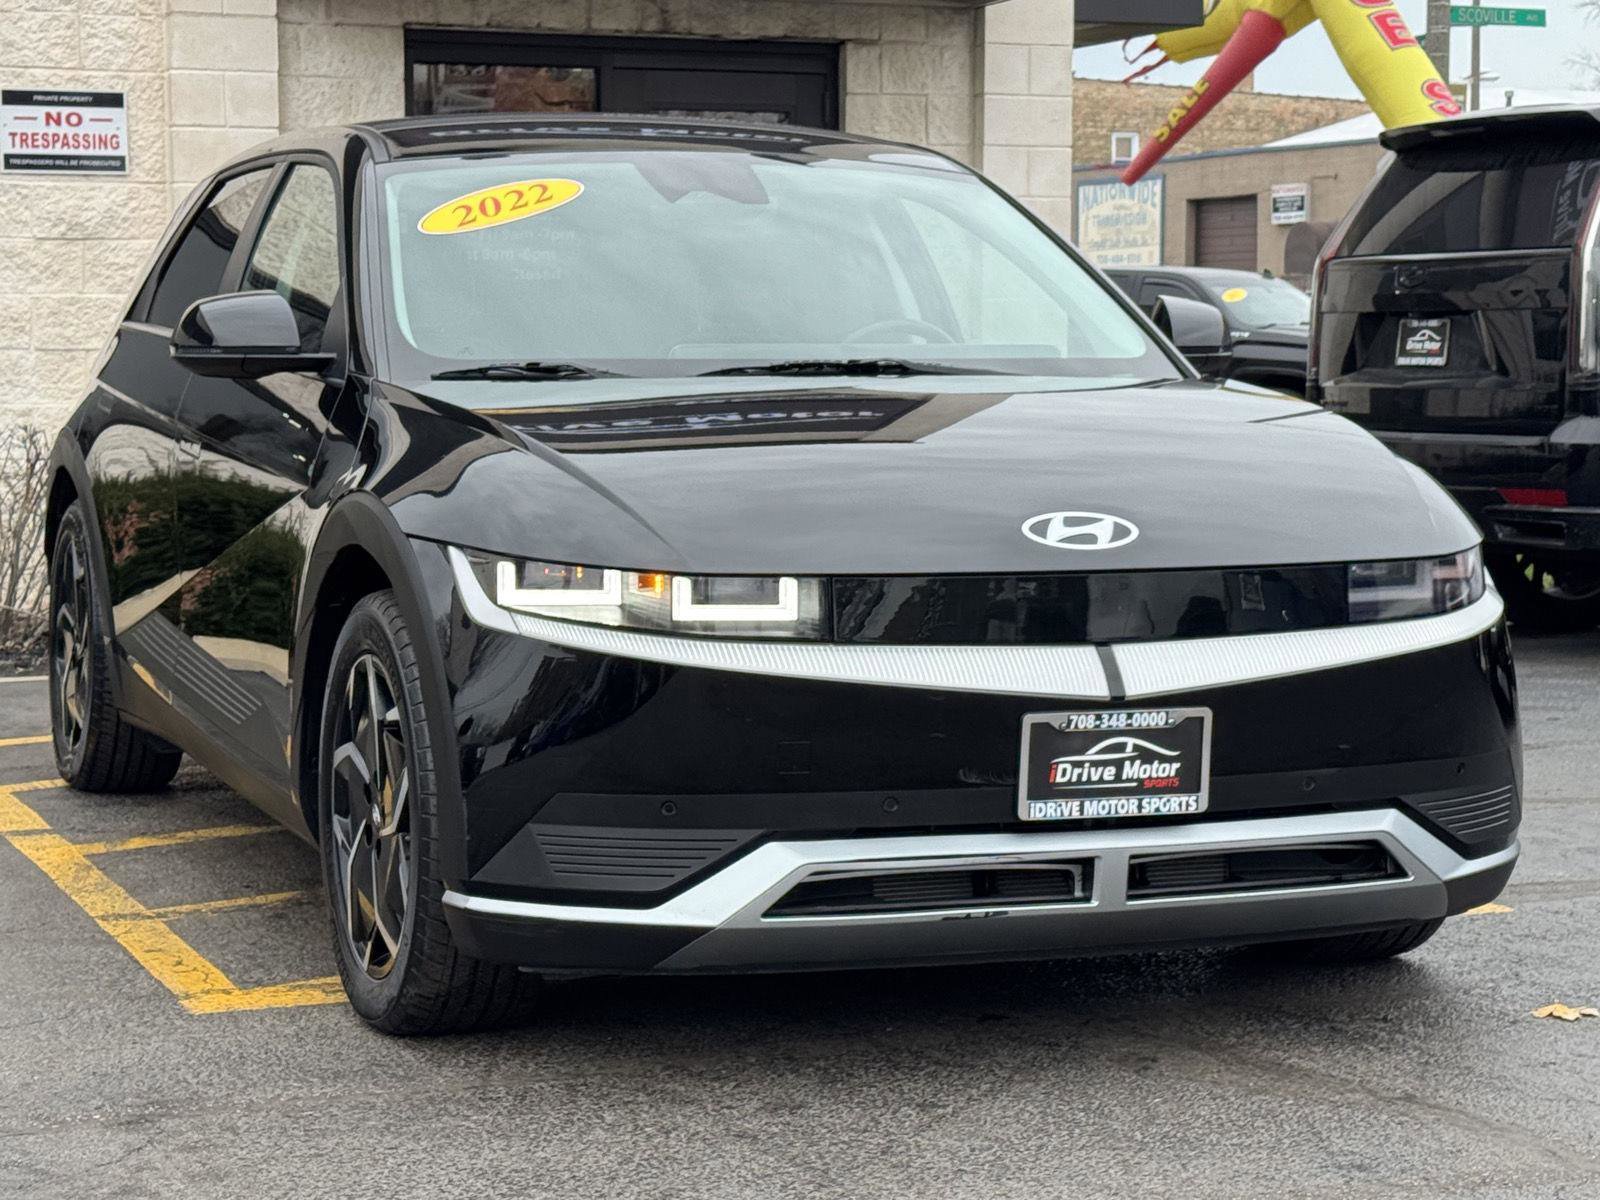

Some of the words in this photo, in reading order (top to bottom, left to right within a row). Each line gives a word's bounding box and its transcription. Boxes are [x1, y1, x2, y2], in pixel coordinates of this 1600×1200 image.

[1458, 7, 1517, 24] SCOVILLE
[44, 111, 83, 127] NO
[8, 132, 120, 150] TRESPASSING
[452, 183, 553, 227] 2022
[1069, 711, 1168, 730] 708-348-0000
[1049, 762, 1117, 784] iDrive
[1121, 759, 1181, 781] Motor
[1143, 777, 1180, 788] SPORTS
[1083, 798, 1139, 816] MOTOR
[1141, 795, 1198, 813] SPORTS
